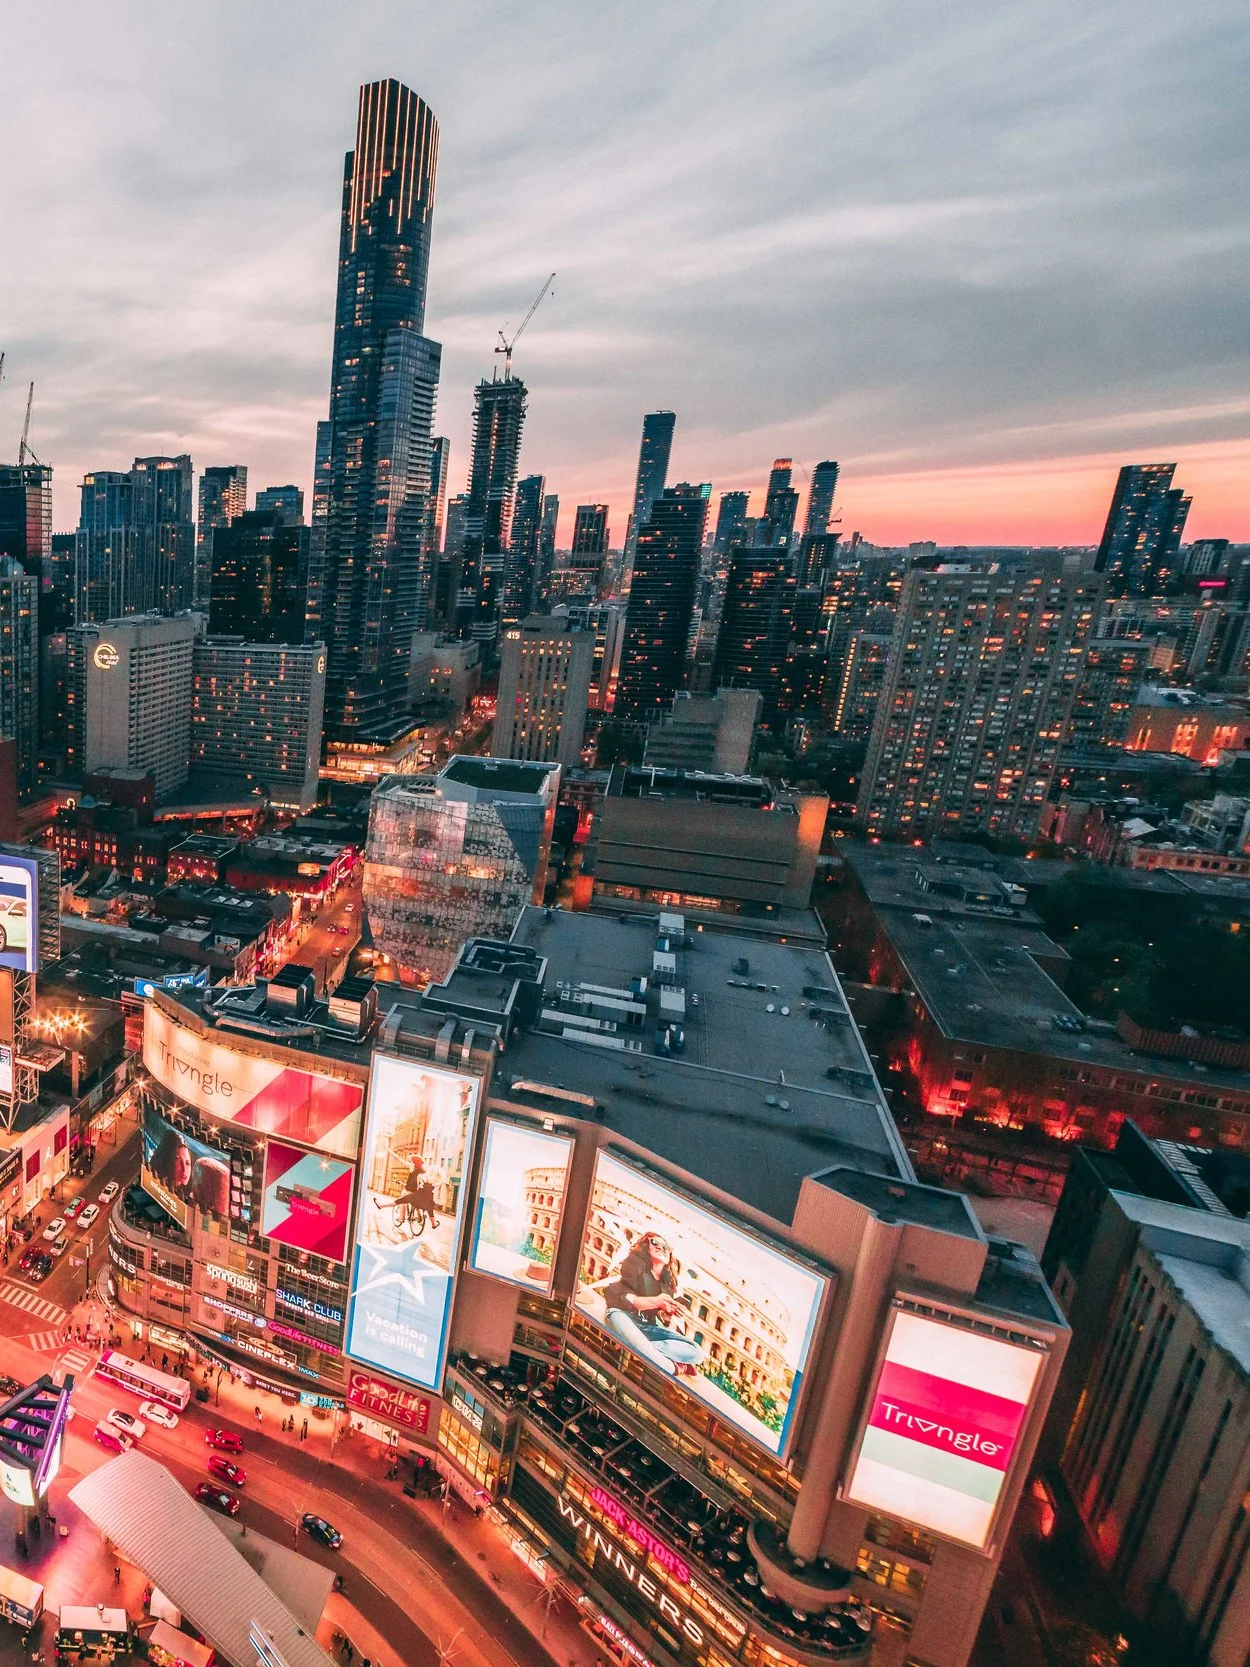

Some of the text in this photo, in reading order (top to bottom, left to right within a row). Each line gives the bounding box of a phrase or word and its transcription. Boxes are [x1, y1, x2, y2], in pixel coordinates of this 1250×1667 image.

[506, 631, 521, 640] 415
[285, 1262, 340, 1289] The Beer Store
[203, 1296, 254, 1320] SHOPPERS
[275, 1288, 341, 1321] SHARK CLUB
[268, 1320, 303, 1342] GoodLife
[301, 1333, 341, 1356] FITNESS
[365, 1323, 426, 1359] is calling
[366, 1310, 428, 1343] Vacation
[237, 1340, 296, 1370] CINEPLEX
[298, 1365, 320, 1379] IMAX
[350, 1388, 424, 1428] FITNESS
[351, 1373, 427, 1412] GoodLife
[453, 1397, 482, 1430] DMZ
[591, 1487, 690, 1584] JACK ASTOR'S
[557, 1495, 704, 1646] WINNERS
